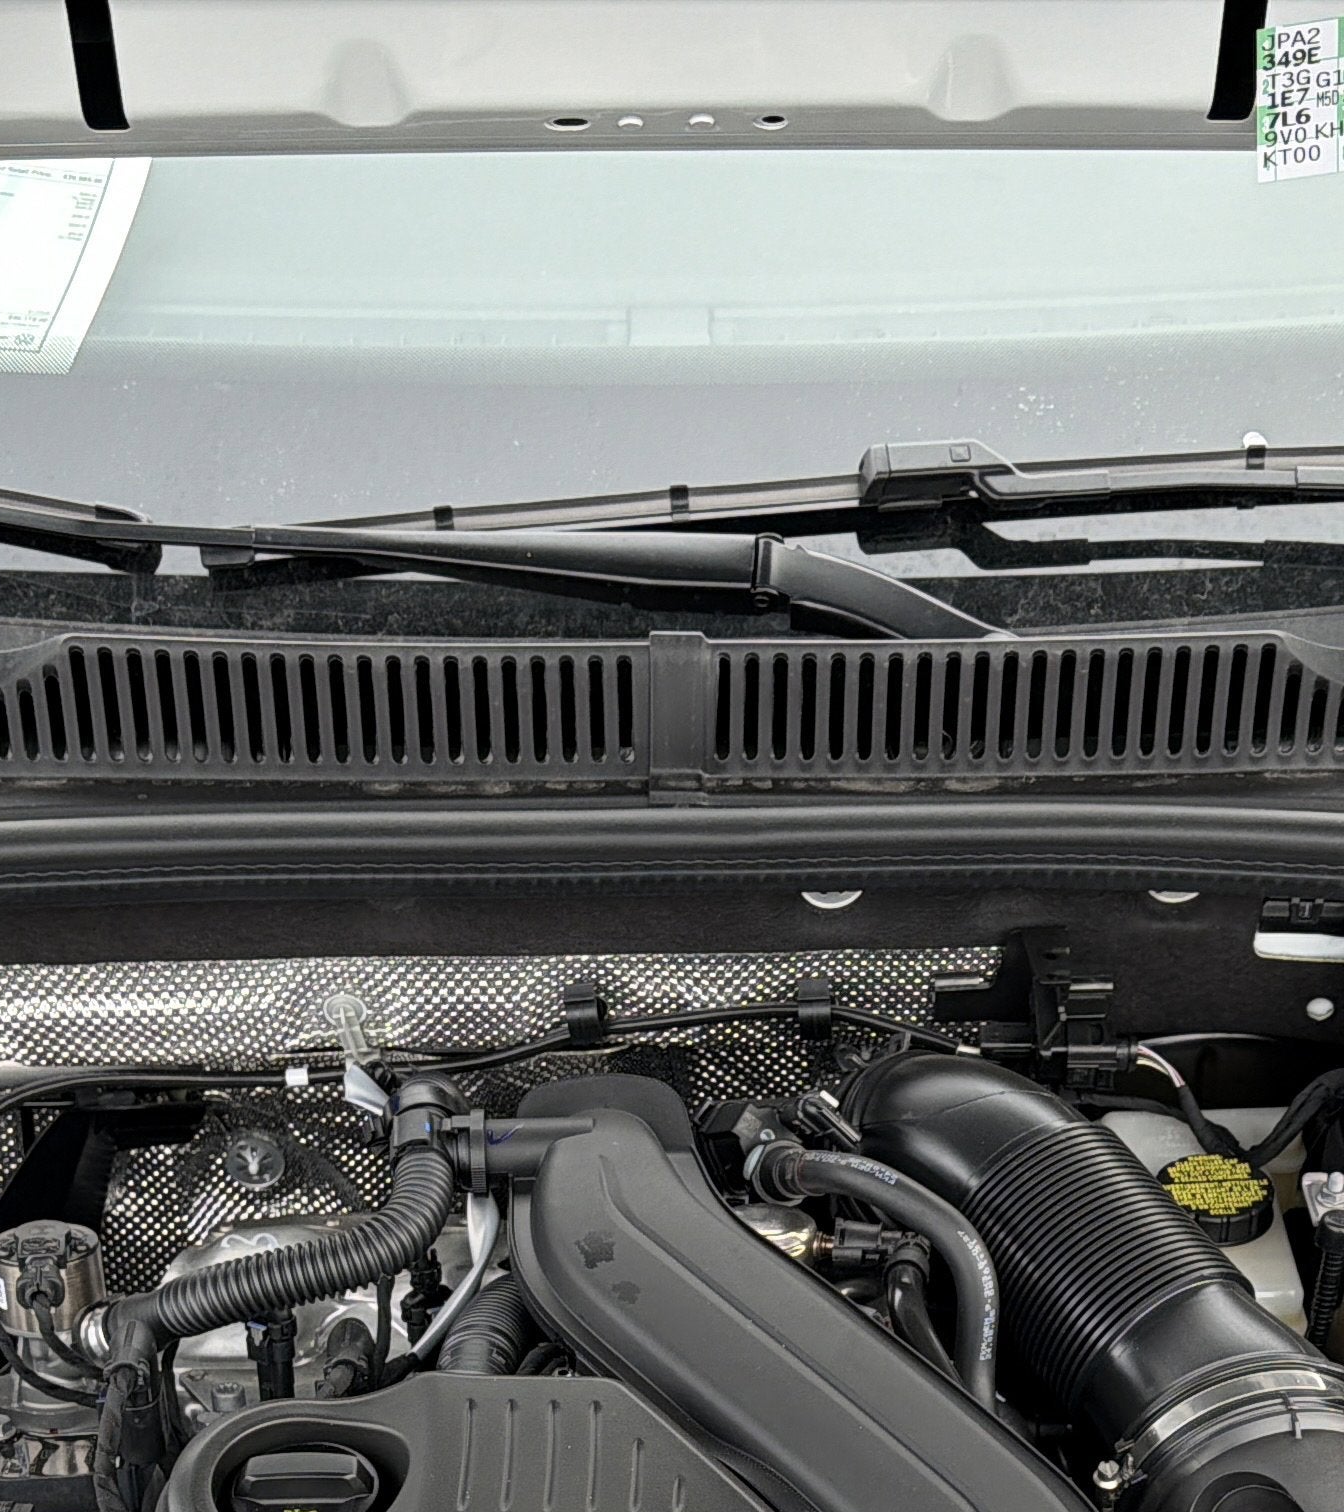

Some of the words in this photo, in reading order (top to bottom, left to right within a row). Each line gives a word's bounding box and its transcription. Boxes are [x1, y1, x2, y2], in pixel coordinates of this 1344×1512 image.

[1261, 27, 1320, 52] JPA2
[1262, 46, 1321, 71] 349E
[1266, 69, 1311, 90] T3G
[1267, 87, 1310, 110] 1E7
[1265, 107, 1311, 129] 7L6
